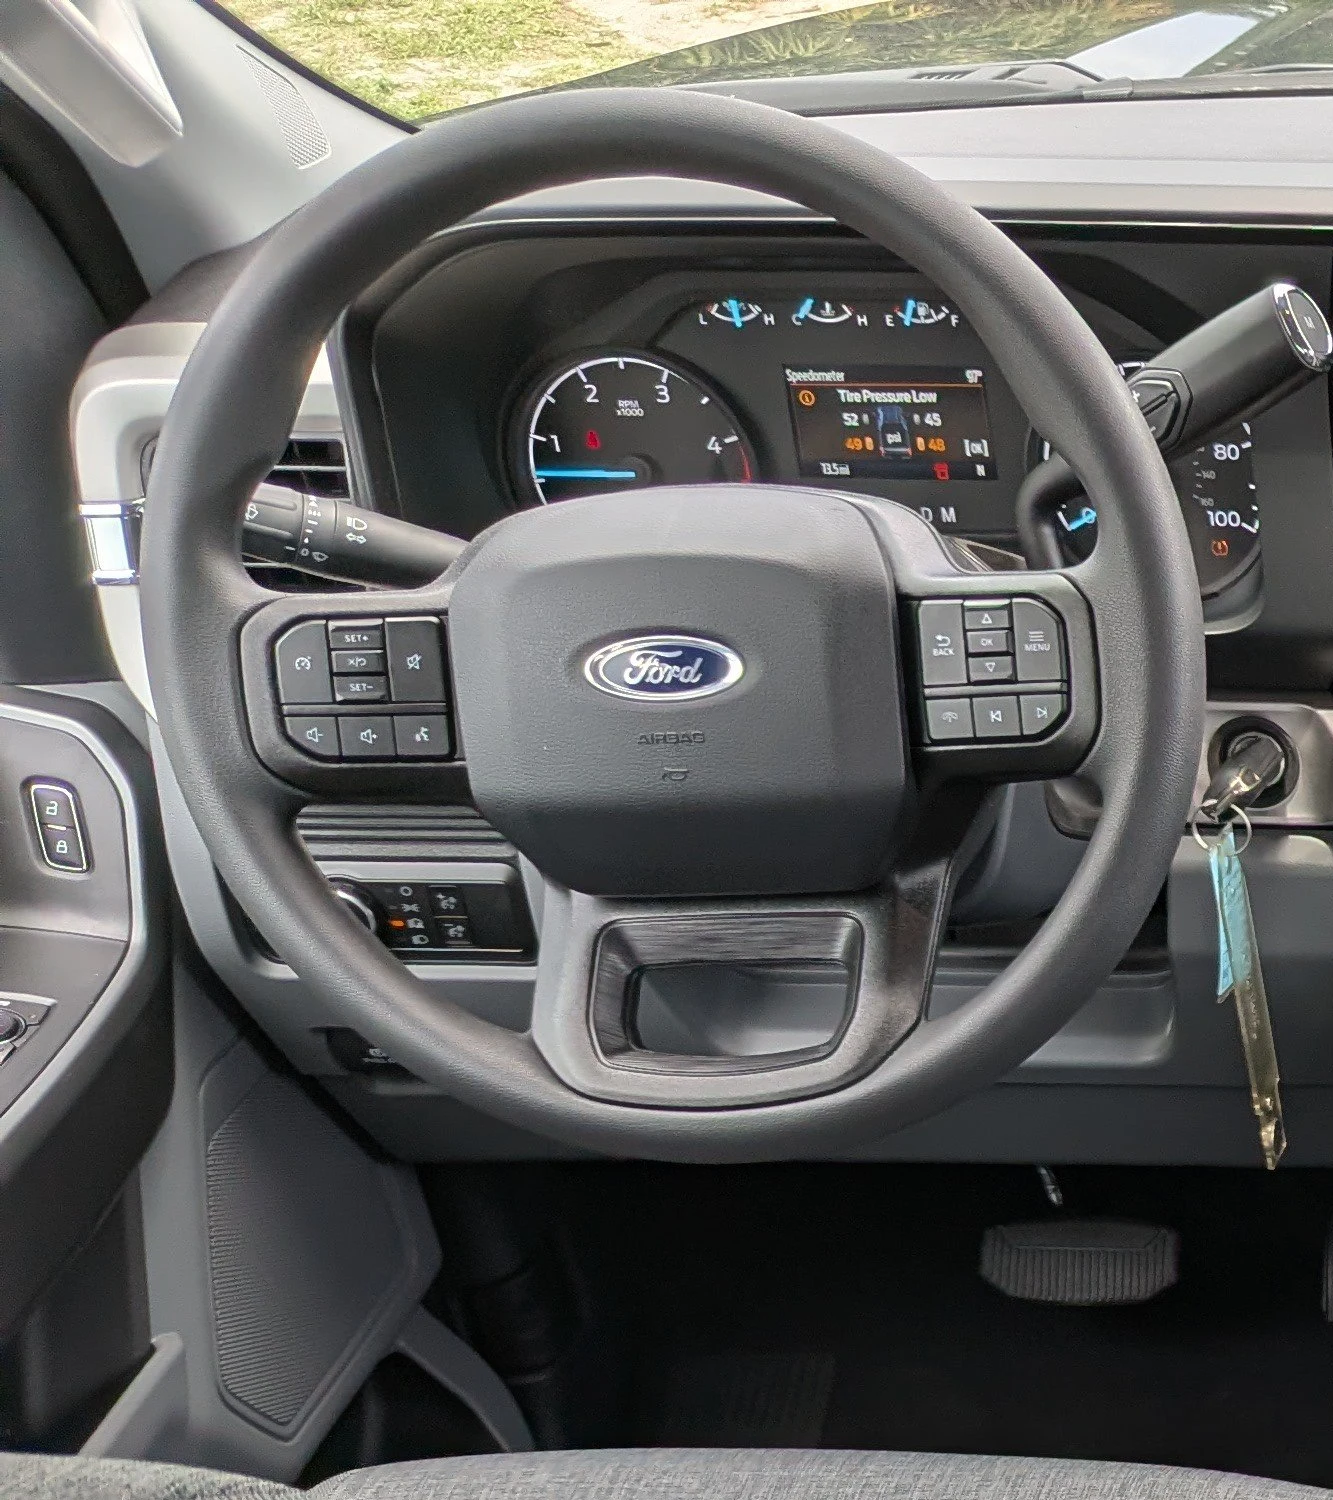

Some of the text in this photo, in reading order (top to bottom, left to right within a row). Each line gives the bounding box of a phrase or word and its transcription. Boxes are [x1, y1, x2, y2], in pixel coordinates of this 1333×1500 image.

[699, 313, 708, 326] L
[764, 314, 775, 326] H
[792, 314, 802, 326] C
[857, 314, 868, 327] H
[885, 314, 895, 327] E
[951, 314, 960, 327] F
[786, 368, 845, 385] Speedometer
[585, 384, 599, 403] 2
[655, 384, 670, 403] 3
[836, 388, 937, 404] Tire Pressure Low
[617, 399, 639, 409] RPM
[842, 412, 859, 427] 52
[924, 412, 942, 427] 45
[550, 434, 561, 453] 1
[706, 435, 723, 454] 4
[844, 437, 863, 451] 49
[1213, 442, 1240, 461] 80
[976, 463, 986, 476] N
[939, 506, 957, 523] M
[1206, 510, 1241, 527] 100
[980, 638, 993, 647] OK
[1023, 642, 1051, 652] MENU
[932, 647, 955, 657] BACK
[623, 650, 704, 685] Ford
[637, 730, 706, 745] AIRBAG
